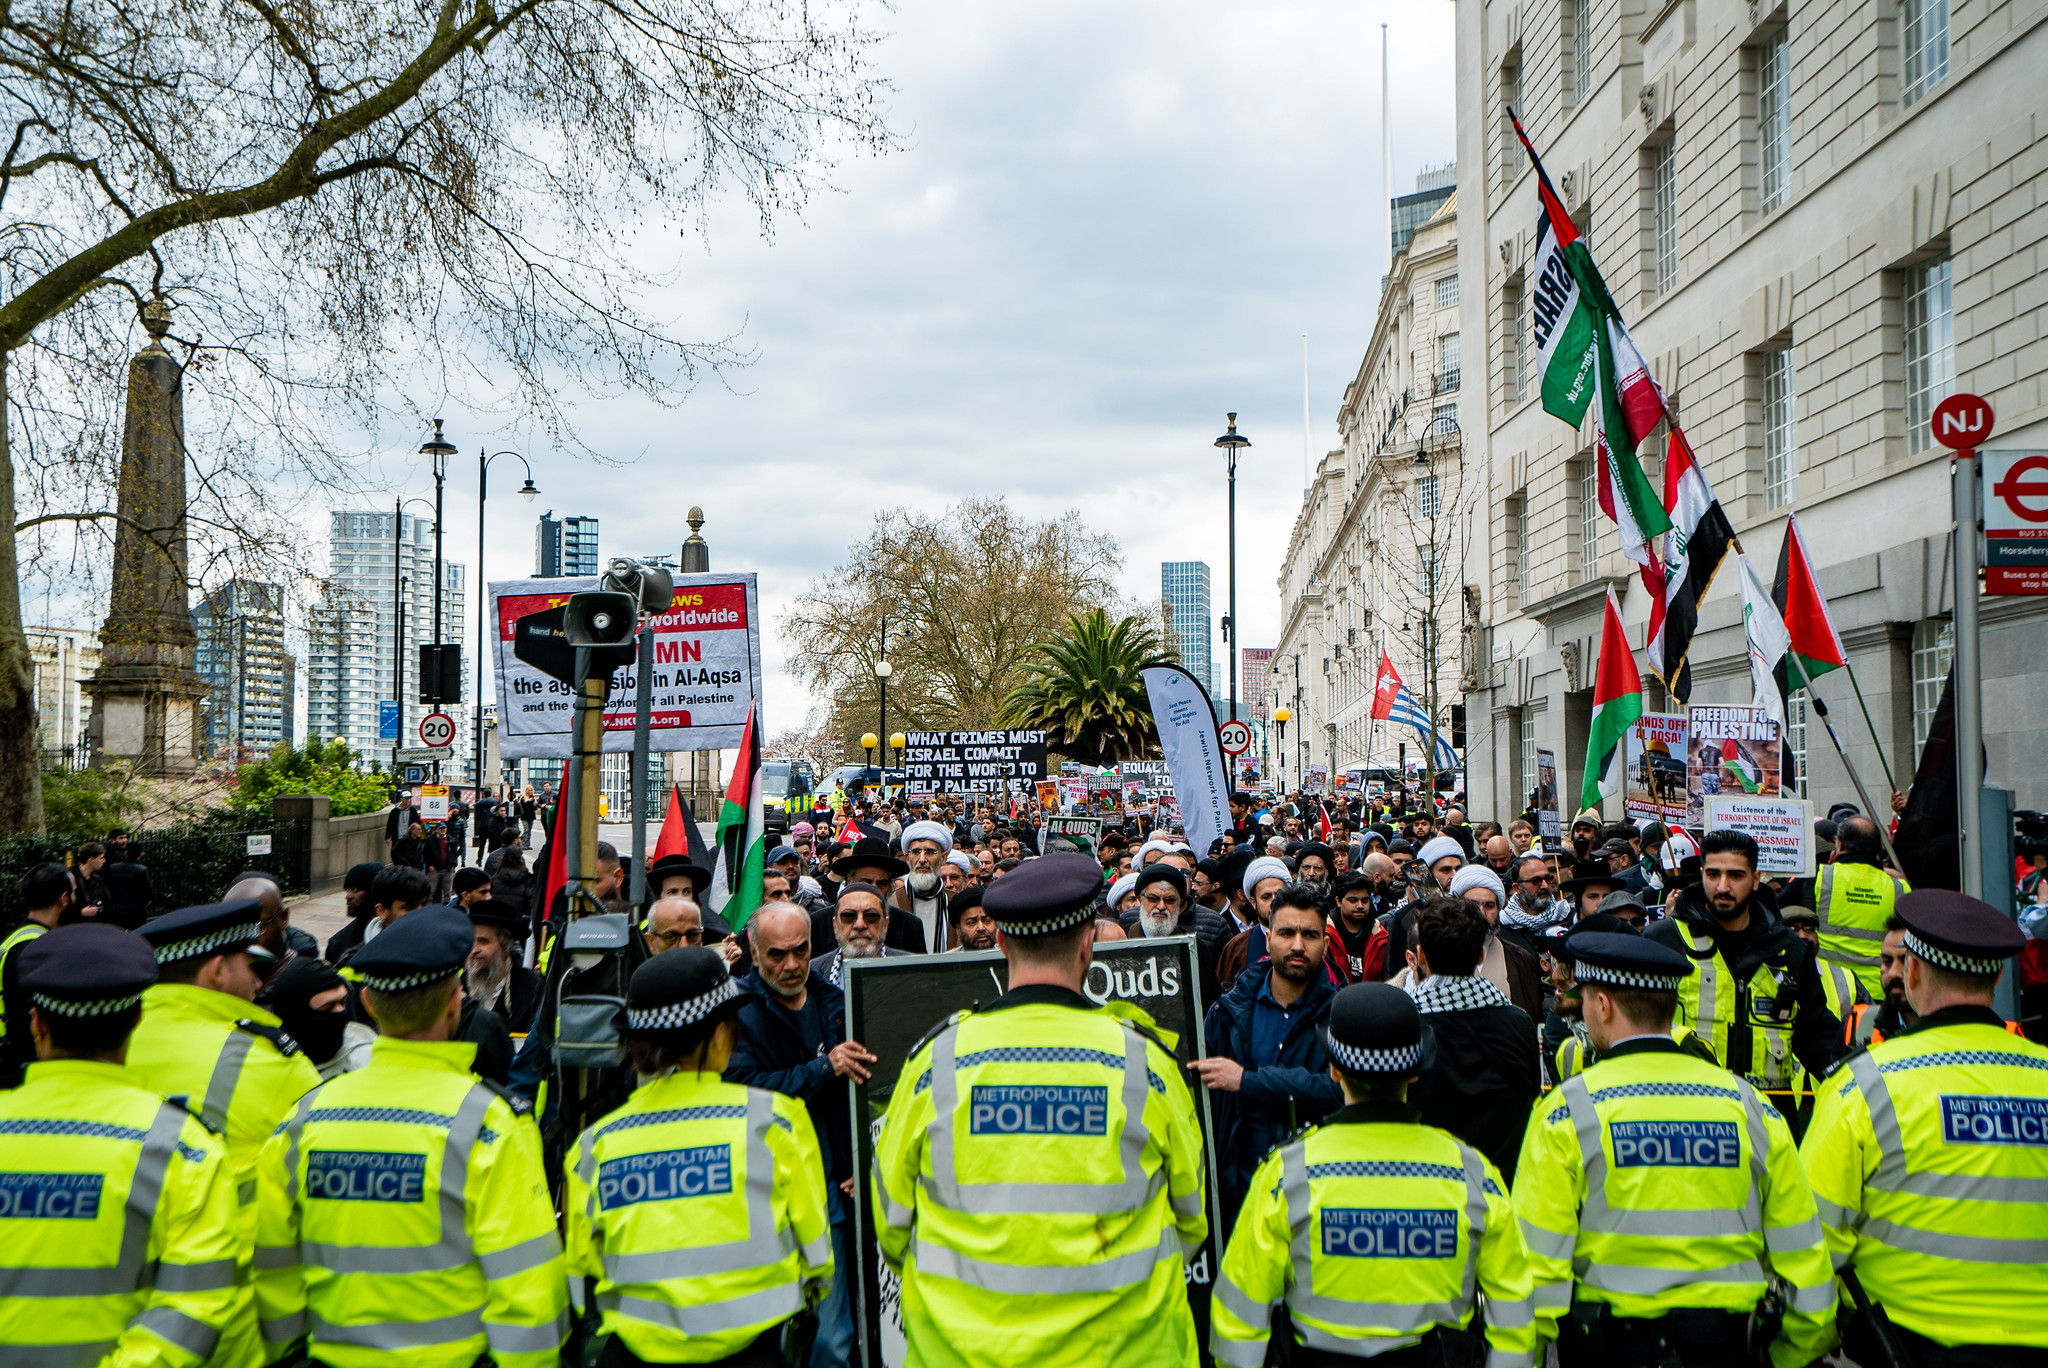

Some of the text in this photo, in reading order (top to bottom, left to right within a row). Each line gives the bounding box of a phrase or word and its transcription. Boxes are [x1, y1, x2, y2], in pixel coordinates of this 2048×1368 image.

[1942, 408, 1984, 435] NJ
[2000, 546, 2048, 557] Horseferry
[2003, 571, 2027, 579] Buses
[2022, 581, 2040, 589] stop
[670, 594, 704, 607] ews
[649, 609, 739, 627] worldwide
[513, 677, 543, 694] the
[654, 671, 668, 688] in
[675, 667, 742, 688] Al-Aqsa
[522, 701, 545, 713] and
[548, 700, 569, 711] the
[660, 695, 674, 707] all
[678, 693, 735, 706] Palestine
[1691, 708, 1749, 722] FREEDOM
[425, 723, 450, 738] 20
[1668, 719, 1687, 731] OFF
[1691, 721, 1777, 741] PALESTINE
[907, 730, 1046, 746] WHAT CRIMES MUST
[1222, 731, 1246, 745] 20
[1636, 729, 1682, 744] AL AQSA!
[905, 748, 960, 762] ISRAEL
[1198, 730, 1210, 758] Jewish
[1205, 759, 1218, 795] Network
[905, 764, 933, 778] FOR
[937, 763, 964, 777] THE
[968, 763, 1016, 777] WORD
[1019, 762, 1037, 776] TO
[1122, 762, 1161, 774] EQUAL
[905, 780, 941, 794] HELP
[429, 801, 441, 809] 88
[1732, 806, 1765, 814] Existence
[1776, 807, 1787, 815] the
[1050, 821, 1097, 834] AL QUDS
[1717, 814, 1751, 823] TERRORIST
[1753, 816, 1770, 824] STATE
[1781, 817, 1801, 826] ISRAEL
[1773, 847, 1797, 855] religion
[1083, 957, 1180, 1006] Quds
[973, 1088, 1106, 1103] METROPOLITAN
[1949, 1099, 2048, 1116] METROPOLITA
[973, 1103, 1105, 1132] POLICE
[1612, 1123, 1737, 1137] METROPOLITAN
[1614, 1137, 1738, 1165] POLICE
[310, 1153, 426, 1169] METROPOLITAN
[600, 1146, 729, 1178] METROPOLITAN
[2, 1174, 102, 1188] ROPOLITAN
[308, 1168, 423, 1199] POLICE
[600, 1162, 730, 1208] POLICE
[1324, 1211, 1456, 1227] METROPOLITAN
[1325, 1227, 1455, 1256] POLICE
